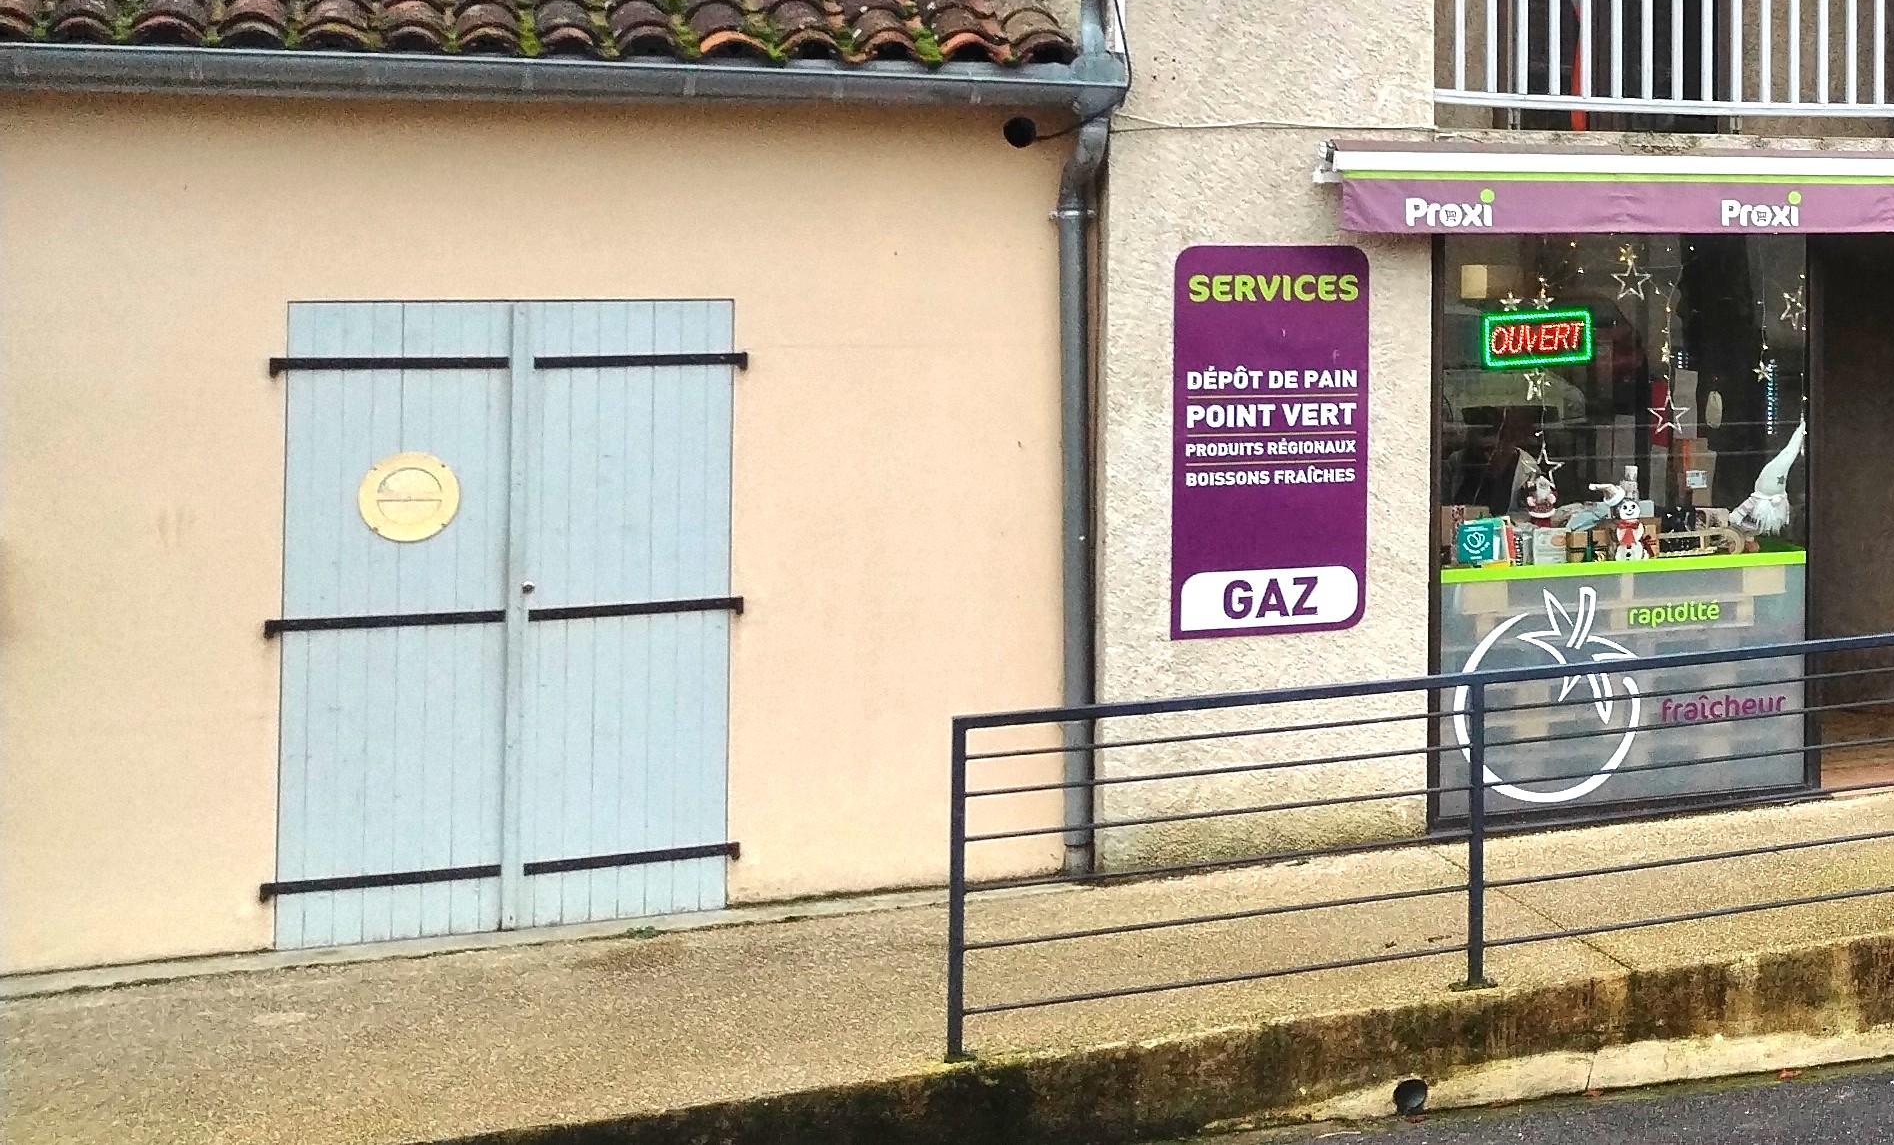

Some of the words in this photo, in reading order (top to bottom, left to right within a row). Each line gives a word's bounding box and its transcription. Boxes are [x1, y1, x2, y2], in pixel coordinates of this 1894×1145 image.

[1405, 188, 1495, 227] Proxi
[1721, 191, 1801, 227] Proxi
[1188, 274, 1359, 302] SERVICES
[1491, 321, 1585, 355] OUVERT
[1187, 365, 1263, 390] DÉPÔT
[1268, 370, 1298, 389] DE
[1304, 370, 1358, 388] PAIN
[1187, 404, 1275, 428] POINT
[1282, 403, 1357, 426] VERT
[1185, 442, 1264, 457] PRODUITS
[1267, 438, 1356, 455] RÉGIONAUX
[1185, 471, 1270, 487] BOISSONS
[1274, 465, 1356, 484] FRAÎCHES
[1222, 576, 1318, 620] GAZ
[1629, 599, 1720, 628] rapidité
[1661, 694, 1787, 722] fraîcheur
